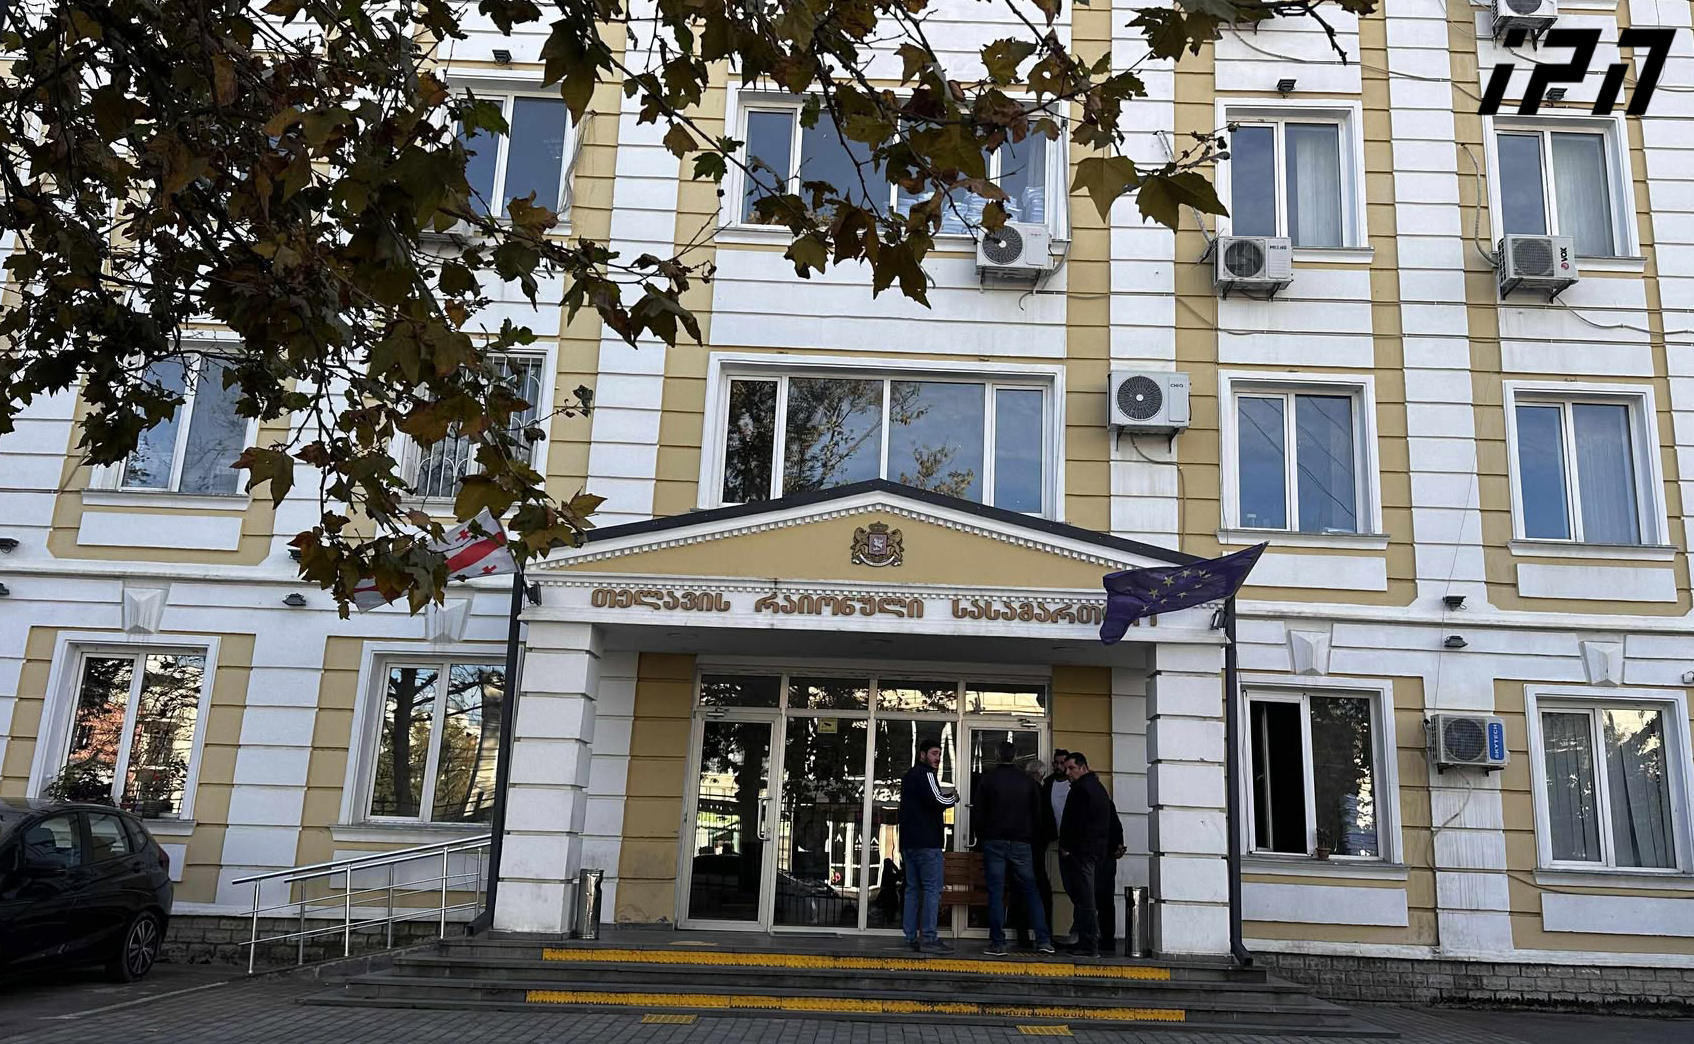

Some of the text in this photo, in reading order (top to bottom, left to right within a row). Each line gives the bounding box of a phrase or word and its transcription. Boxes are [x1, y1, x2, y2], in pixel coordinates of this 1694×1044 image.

[591, 587, 1158, 627] თელავის რაიონული სასამართ
